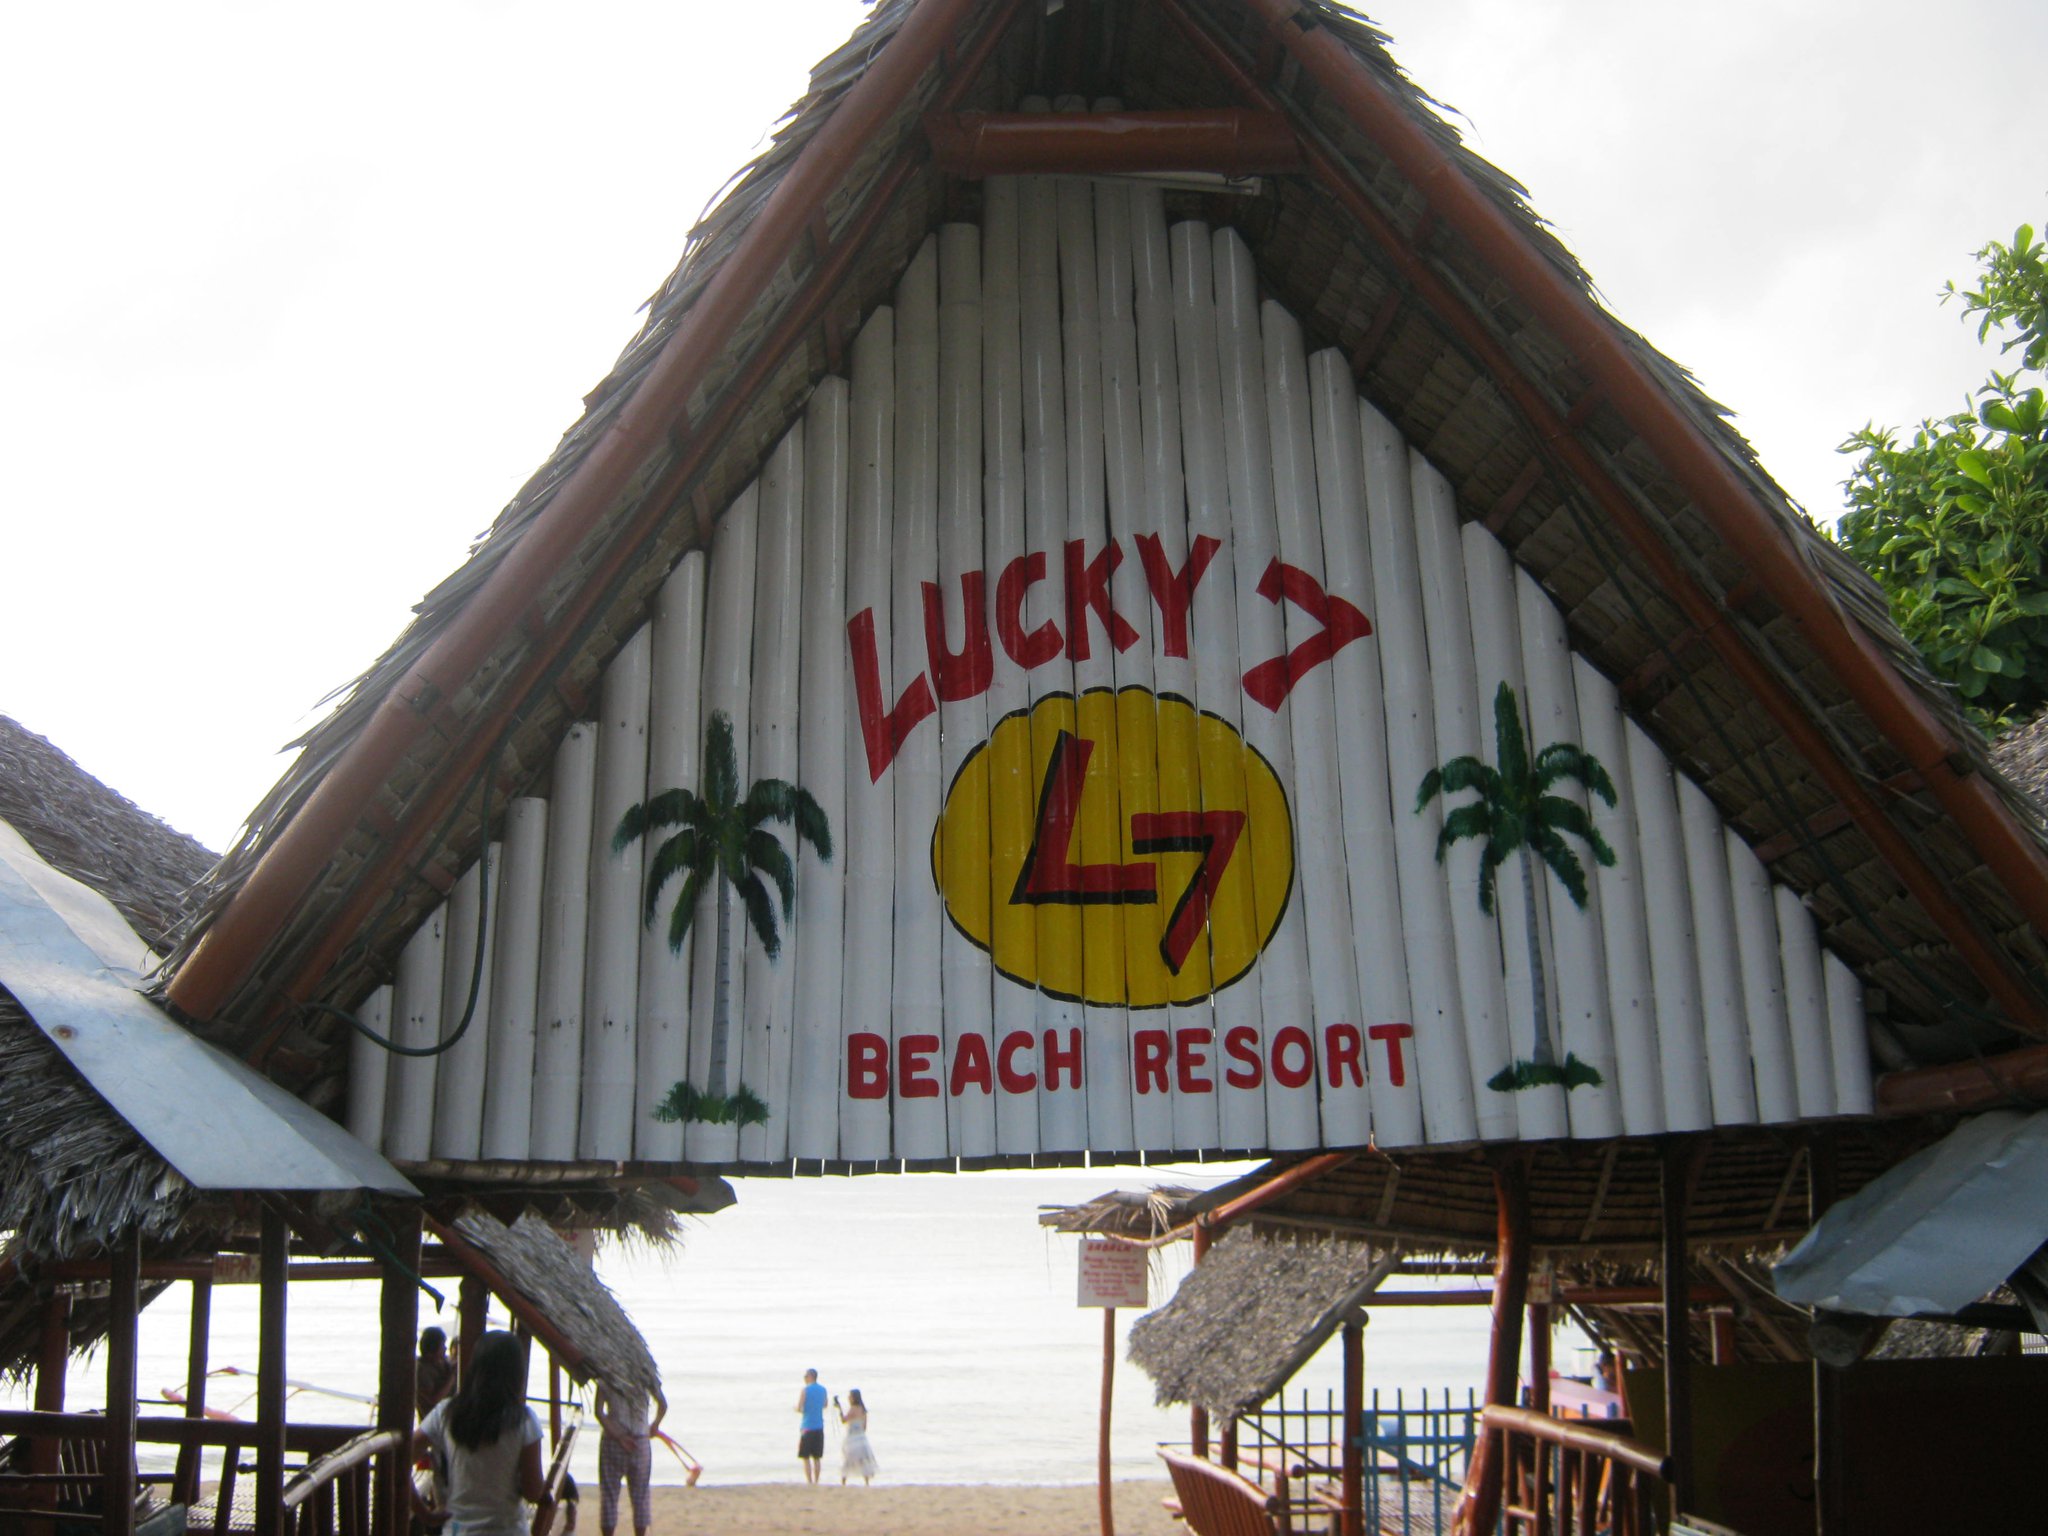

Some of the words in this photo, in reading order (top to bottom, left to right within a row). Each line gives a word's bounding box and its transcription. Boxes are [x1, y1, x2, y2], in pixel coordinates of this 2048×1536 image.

[846, 531, 1222, 786] LUCKY
[1242, 554, 1373, 714] 7
[847, 1027, 1083, 1100] BEACH
[1133, 1022, 1414, 1095] RESORT
